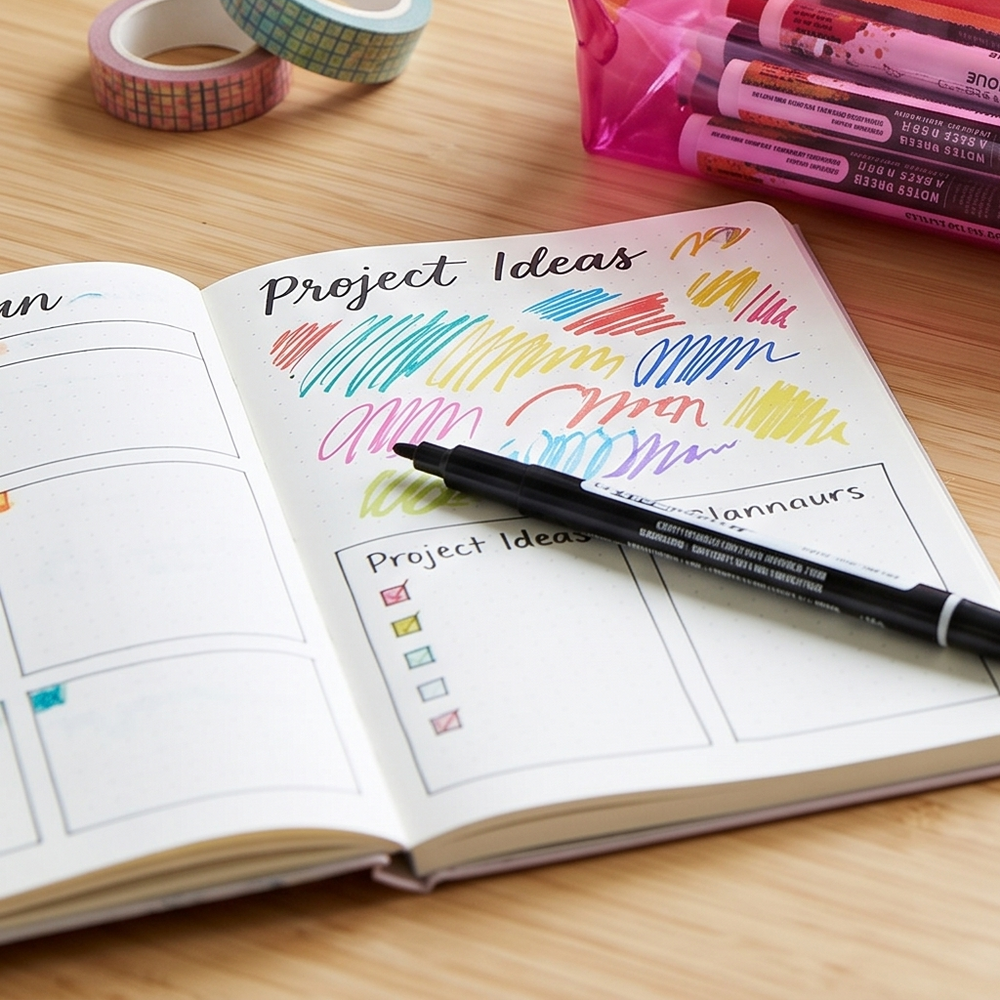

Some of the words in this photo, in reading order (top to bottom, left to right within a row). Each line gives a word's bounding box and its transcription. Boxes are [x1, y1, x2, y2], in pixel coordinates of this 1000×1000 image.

[260, 255, 467, 315] Project
[494, 246, 648, 281] Ideas
[691, 485, 865, 522] lannaurs
[366, 537, 486, 573] Project
[500, 529, 592, 550] Ideas
